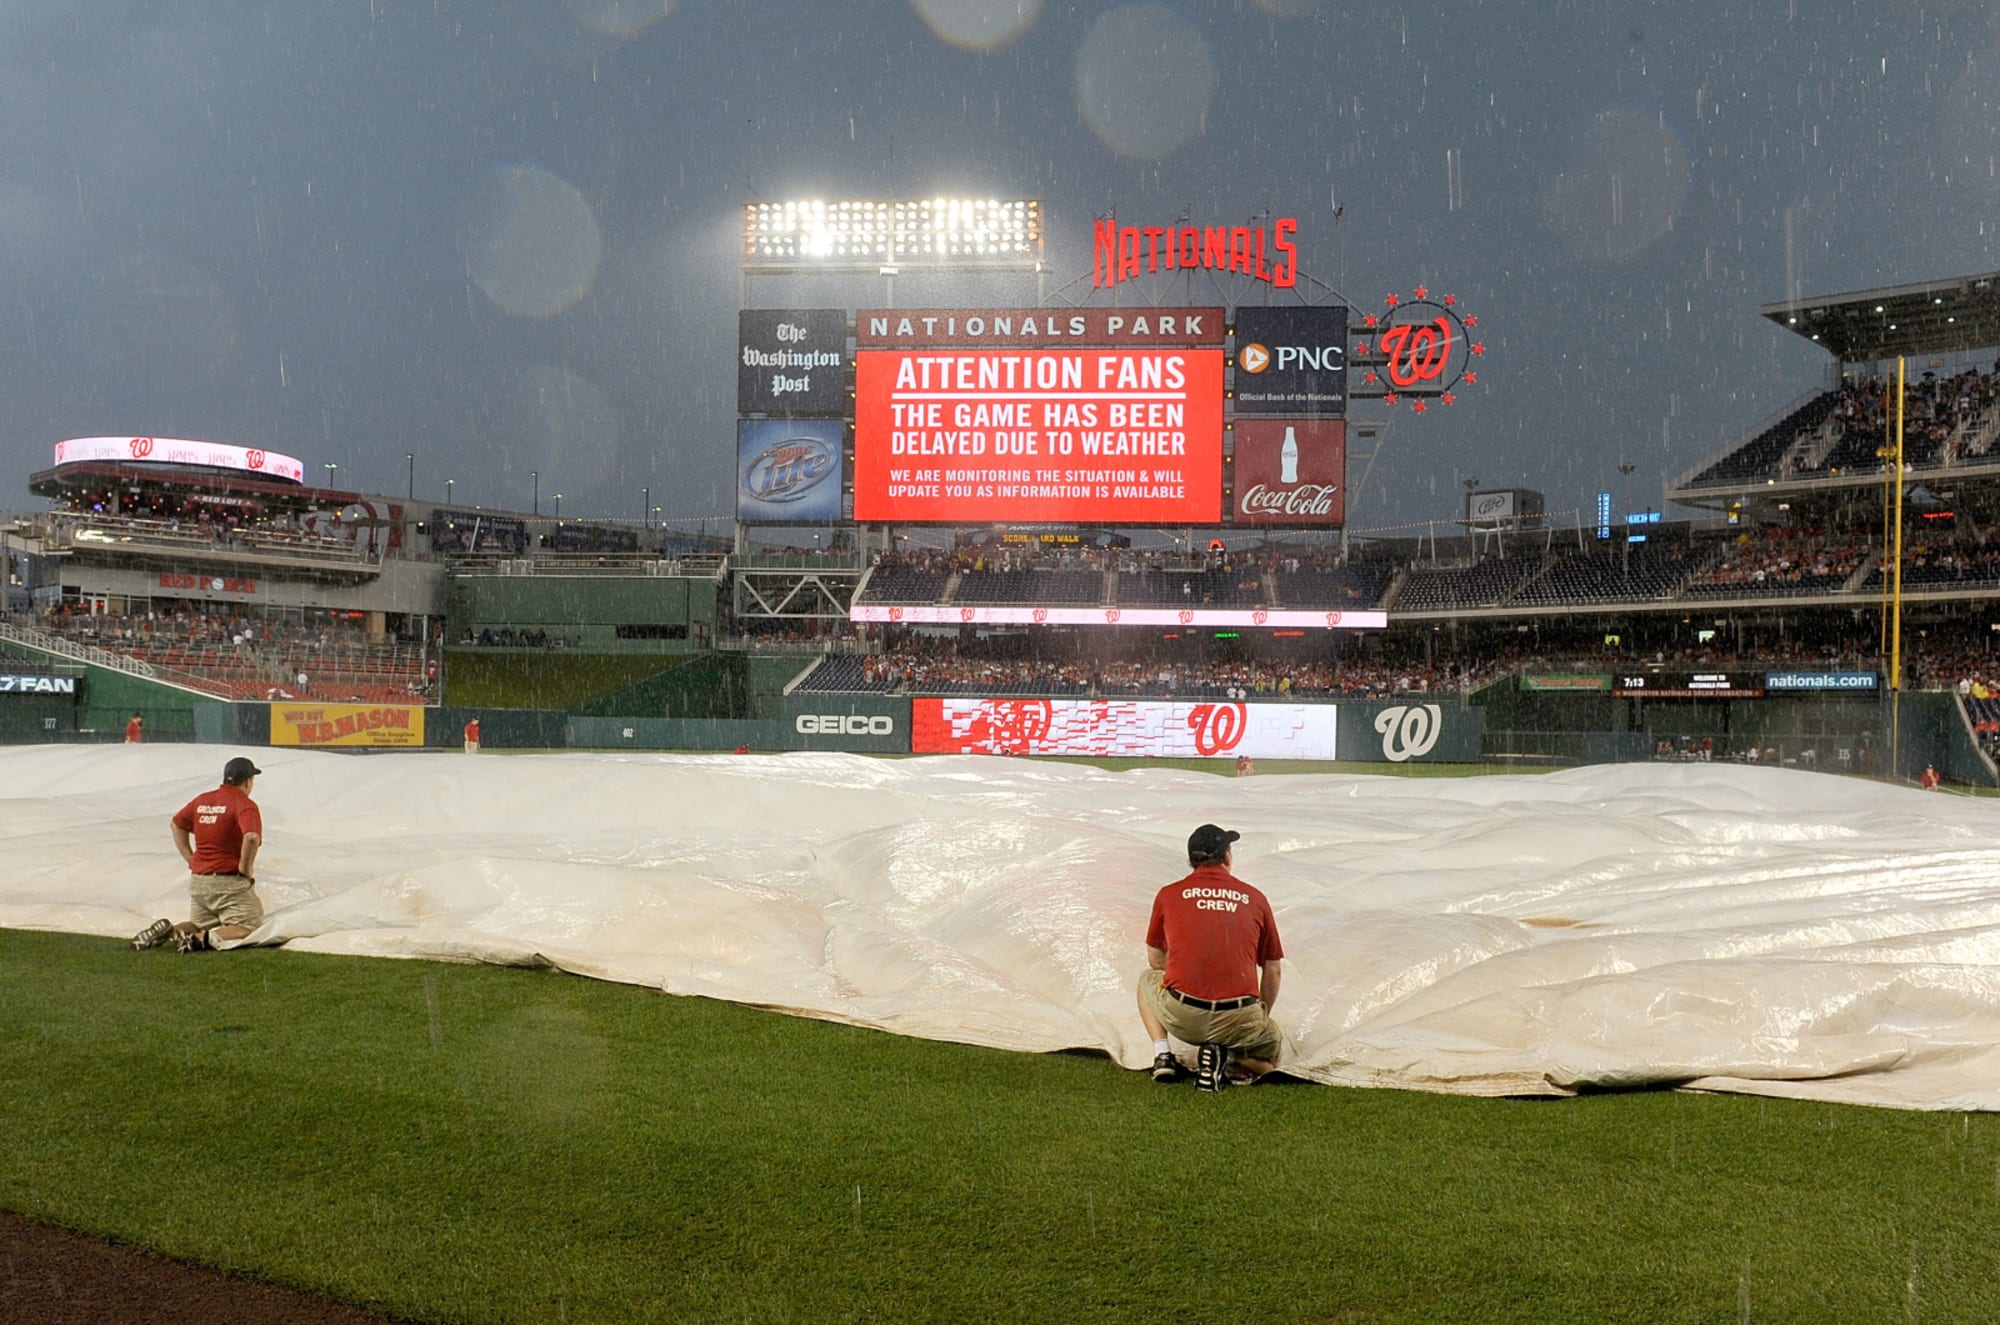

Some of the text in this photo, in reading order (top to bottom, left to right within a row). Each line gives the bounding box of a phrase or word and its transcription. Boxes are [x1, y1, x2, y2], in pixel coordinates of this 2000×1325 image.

[1093, 217, 1297, 289] NATIONALS
[776, 323, 808, 344] The
[870, 315, 1204, 337] NATIONALS PARK
[742, 345, 841, 371] Washington
[1275, 346, 1343, 371] PNC
[895, 355, 1187, 390] ATTENTION FANS
[771, 374, 811, 397] Post
[1239, 392, 1342, 401] Official Bank of the Nationals
[891, 403, 1184, 428] THE GAME HAS BEEN
[891, 431, 1186, 456] DELAYED DUE TO WEATHER
[890, 469, 1184, 483] WE ARE MONITORING THE SITUATION & WILL
[888, 484, 1185, 498] UPDATE YOU AS INFORMATION IS AVAILABLE
[1240, 483, 1338, 515] Coca-Cola
[202, 495, 243, 506] RED LOFT
[1056, 534, 1080, 543] WALK
[159, 572, 197, 590] RED
[20, 677, 75, 693] FAN
[1623, 677, 1645, 688] 7:13
[1768, 673, 1873, 688] nationals.com
[43, 717, 57, 730] 377
[795, 714, 893, 737] GEICO
[197, 805, 227, 814] GROUNDS
[198, 815, 218, 824] CREW
[1182, 887, 1250, 905] GROUNDS
[1196, 899, 1238, 913] CREW
